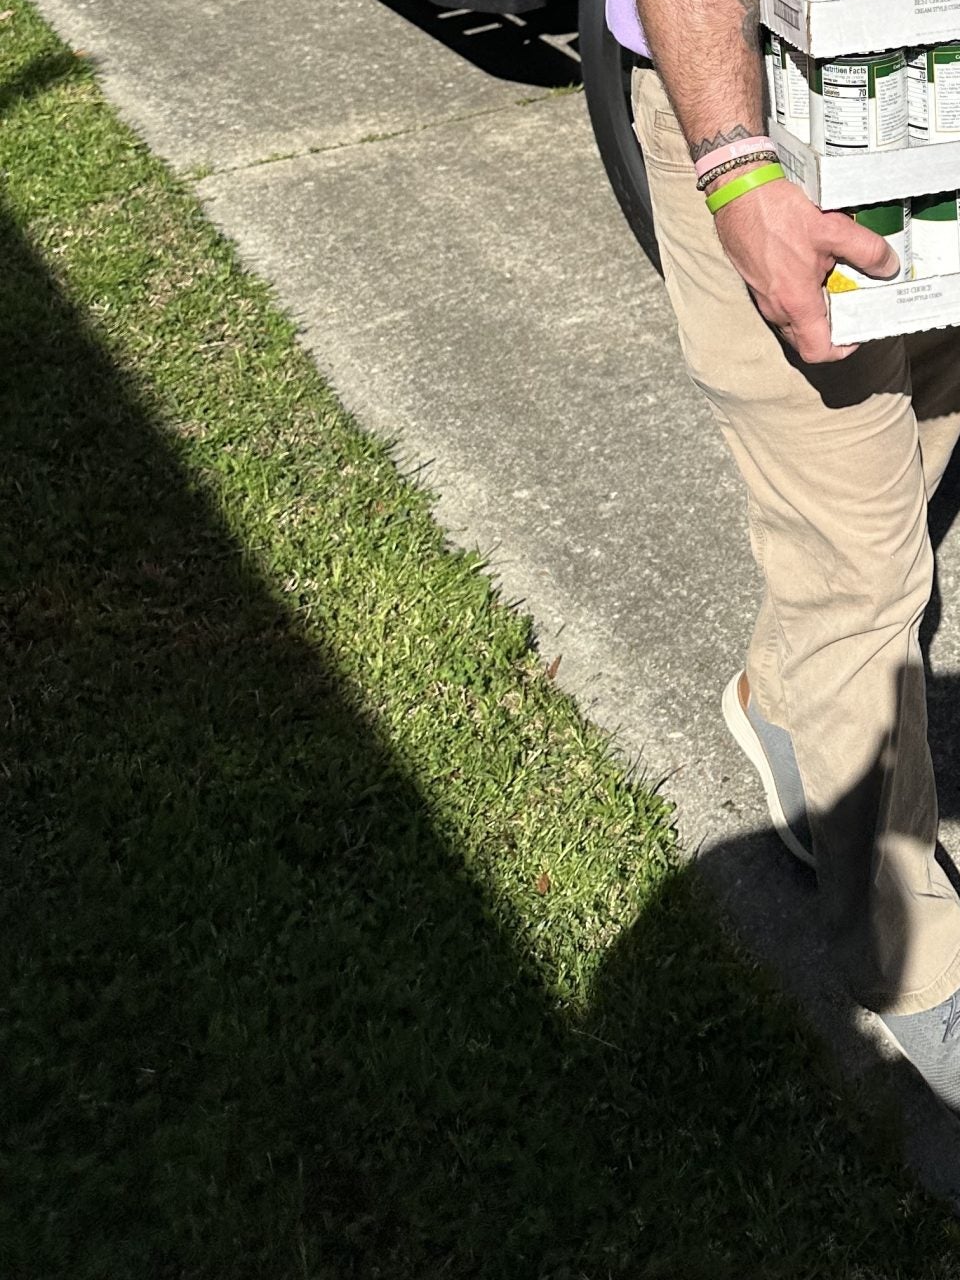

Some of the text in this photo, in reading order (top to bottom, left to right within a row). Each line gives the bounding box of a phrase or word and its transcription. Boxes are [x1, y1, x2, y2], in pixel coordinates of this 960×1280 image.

[824, 65, 867, 75] Nutrition Facts
[858, 88, 867, 97] 70
